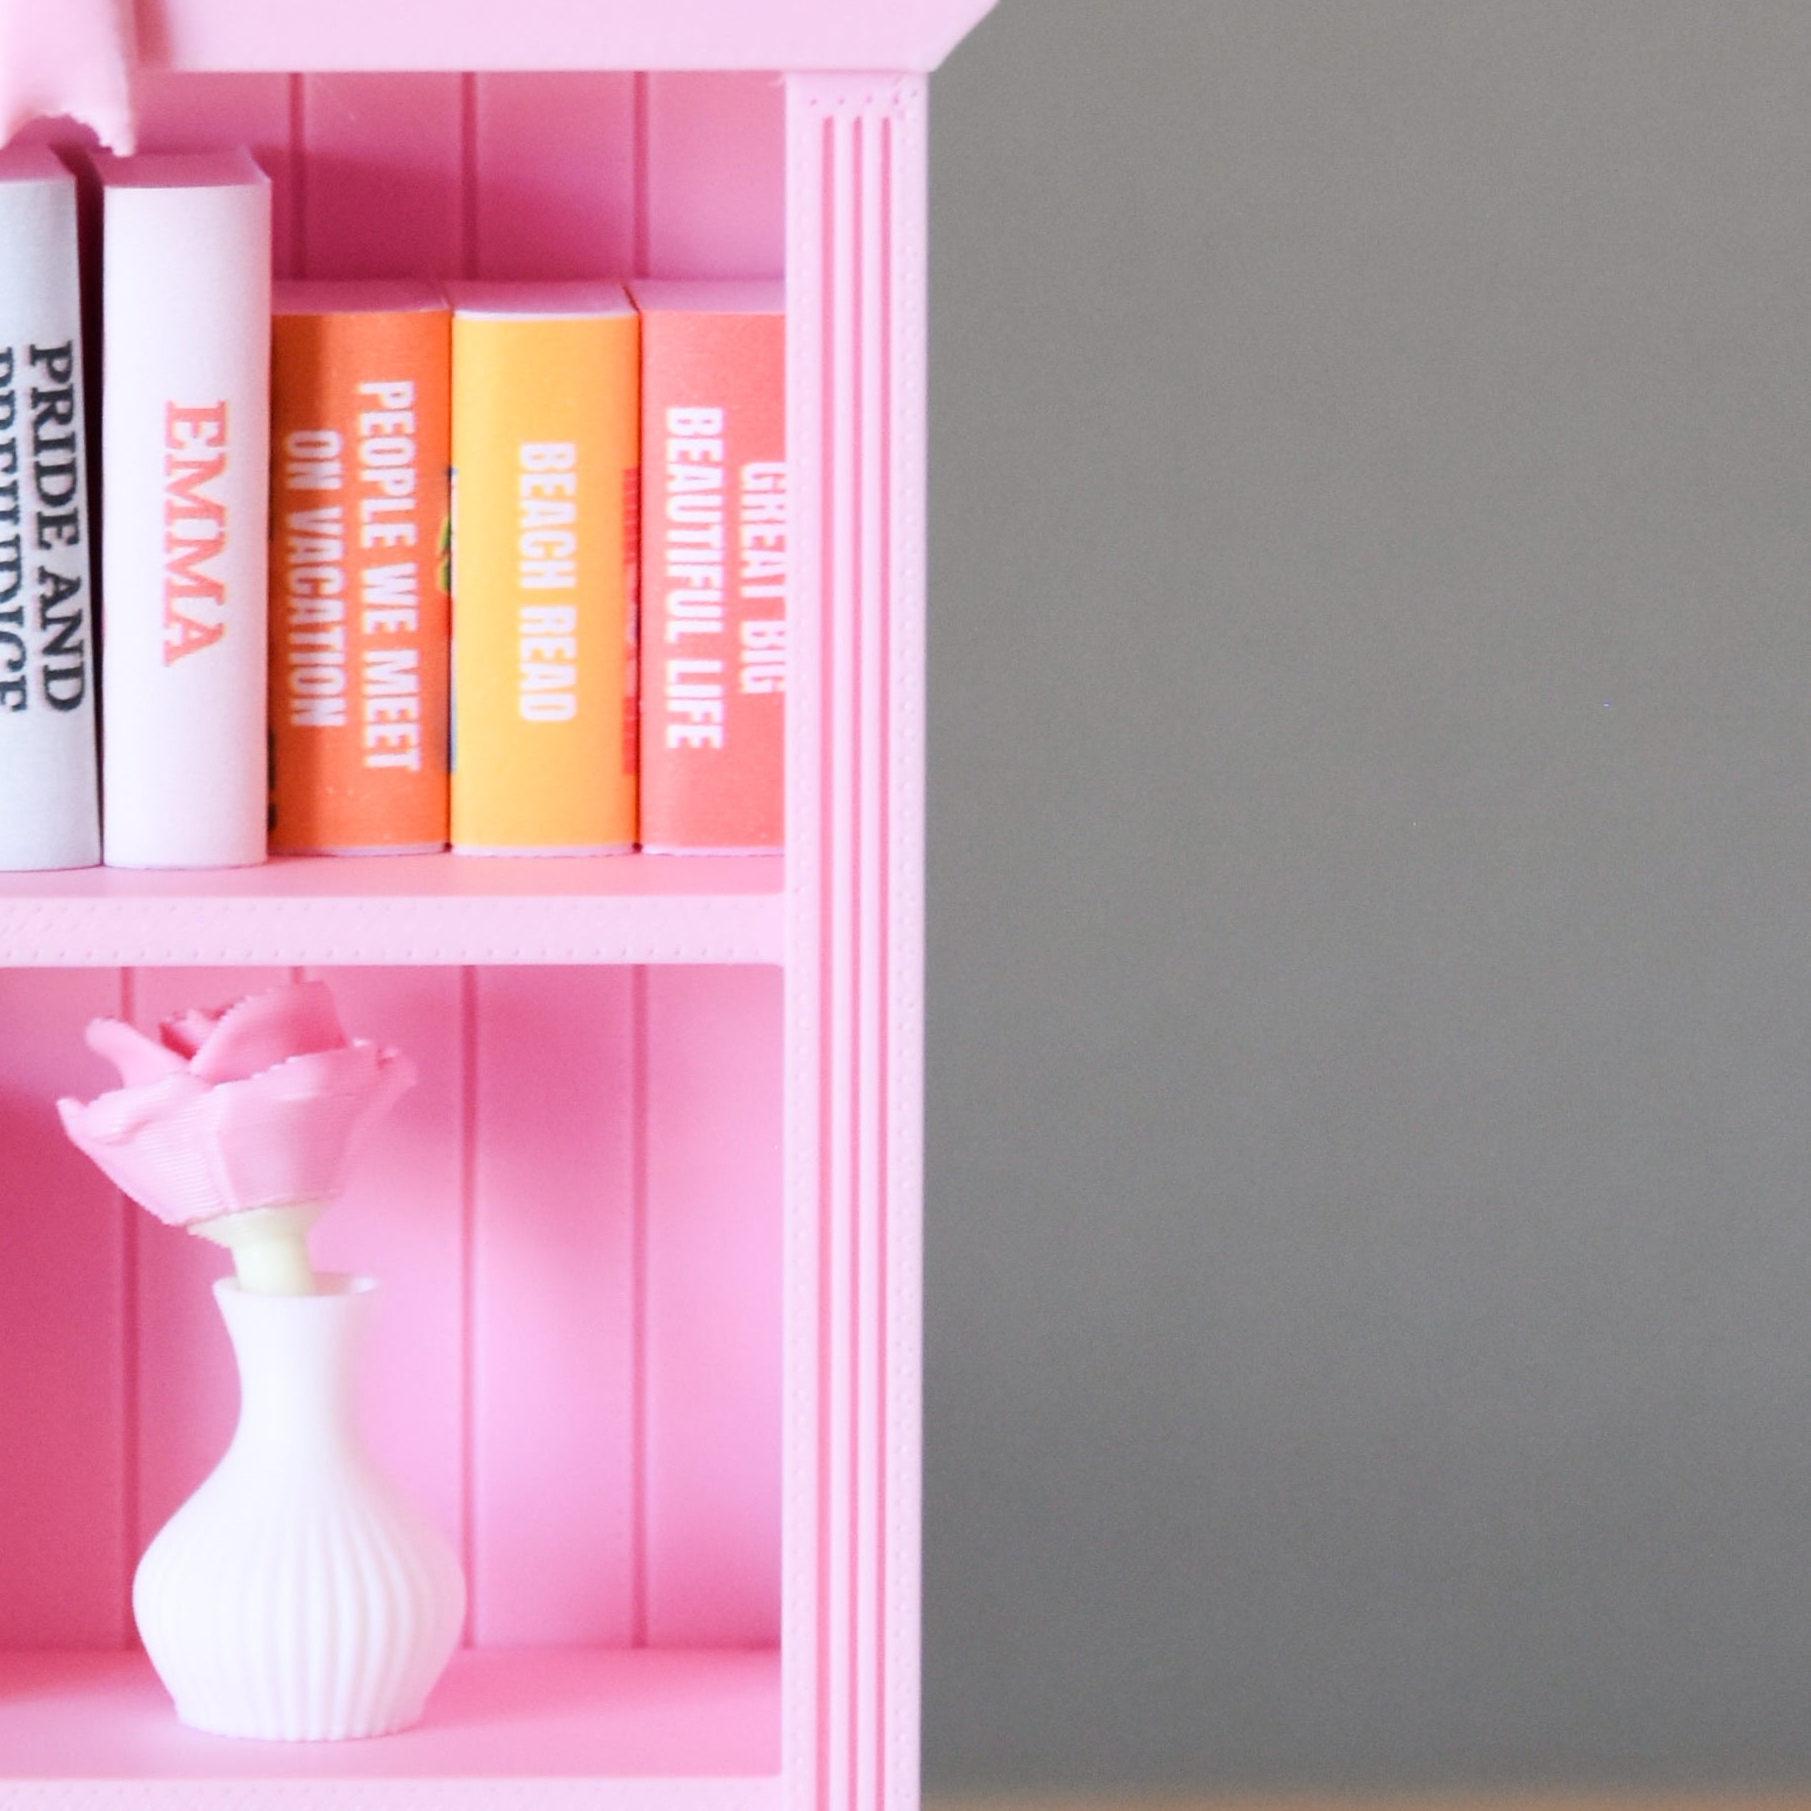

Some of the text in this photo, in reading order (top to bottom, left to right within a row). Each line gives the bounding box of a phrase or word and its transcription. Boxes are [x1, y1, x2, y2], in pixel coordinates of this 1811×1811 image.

[29, 339, 88, 712] PRIDE AND
[164, 401, 227, 667] EMMA
[284, 429, 346, 727] ON VACATION
[358, 379, 422, 773] PEOPLE WE MEET
[519, 442, 576, 722] BEACH READ
[665, 405, 723, 750] BEAUTIFUL LIFE
[739, 462, 786, 694] GREAT BIG
